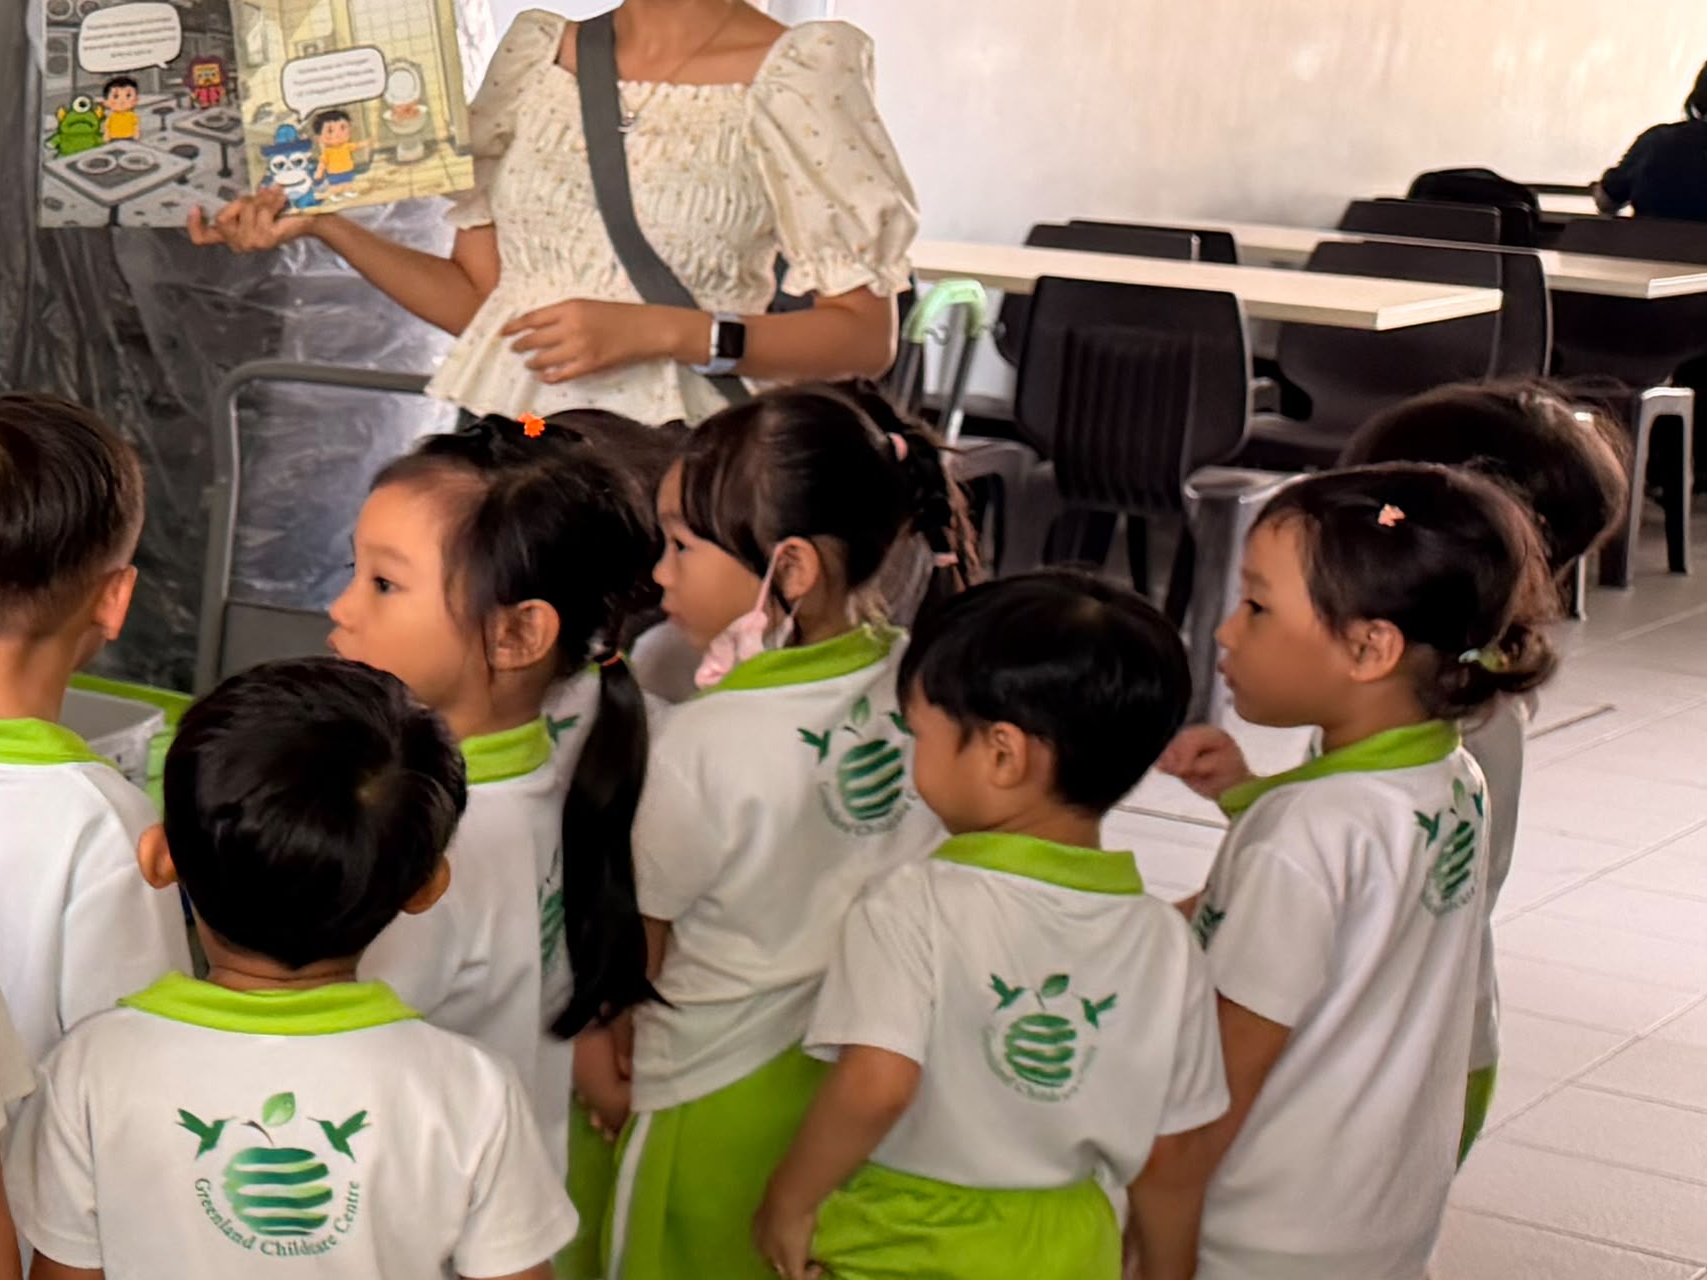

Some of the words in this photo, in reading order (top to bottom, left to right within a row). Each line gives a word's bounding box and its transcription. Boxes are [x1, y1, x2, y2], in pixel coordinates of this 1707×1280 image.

[194, 1177, 256, 1251] Greenland
[260, 1236, 338, 1258] Childcare
[333, 1180, 361, 1235] Centre
